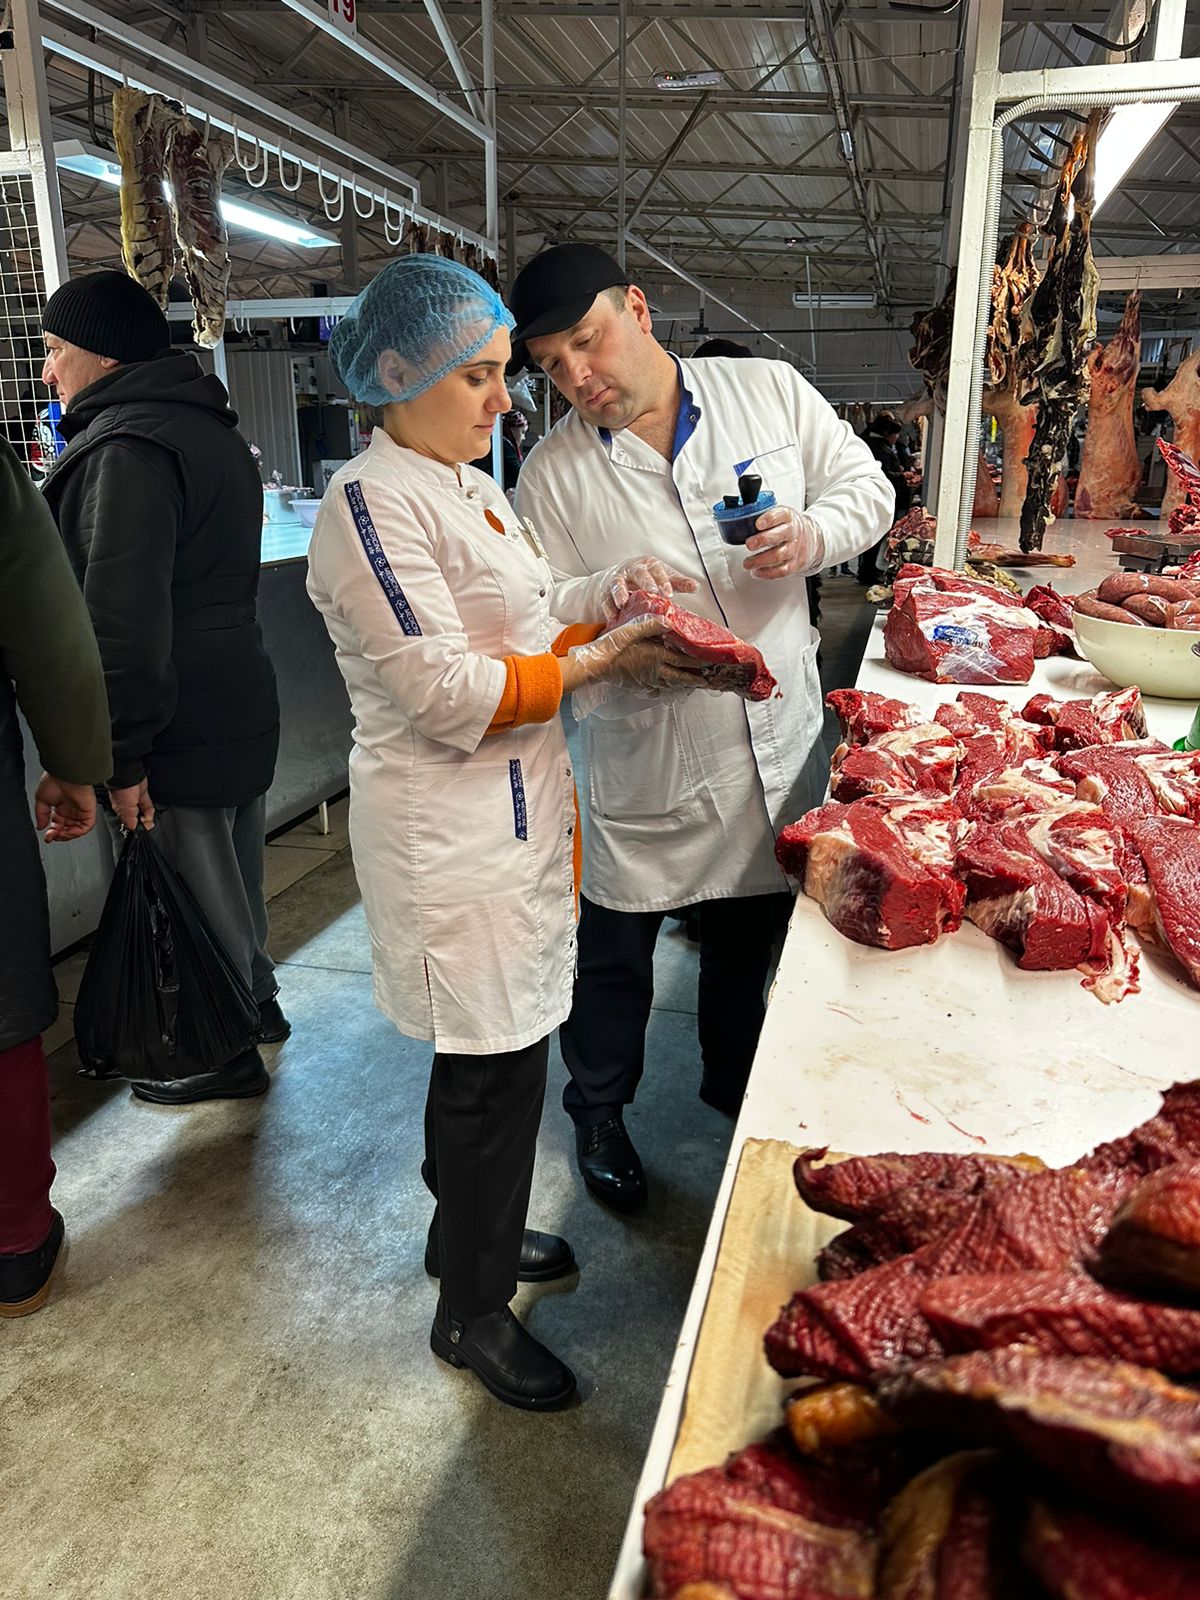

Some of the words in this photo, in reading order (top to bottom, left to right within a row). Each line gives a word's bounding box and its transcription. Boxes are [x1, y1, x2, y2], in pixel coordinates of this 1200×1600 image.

[353, 483, 366, 511] MEDICINE
[367, 525, 382, 554] MEDICINE
[384, 566, 401, 595] MEDICINE
